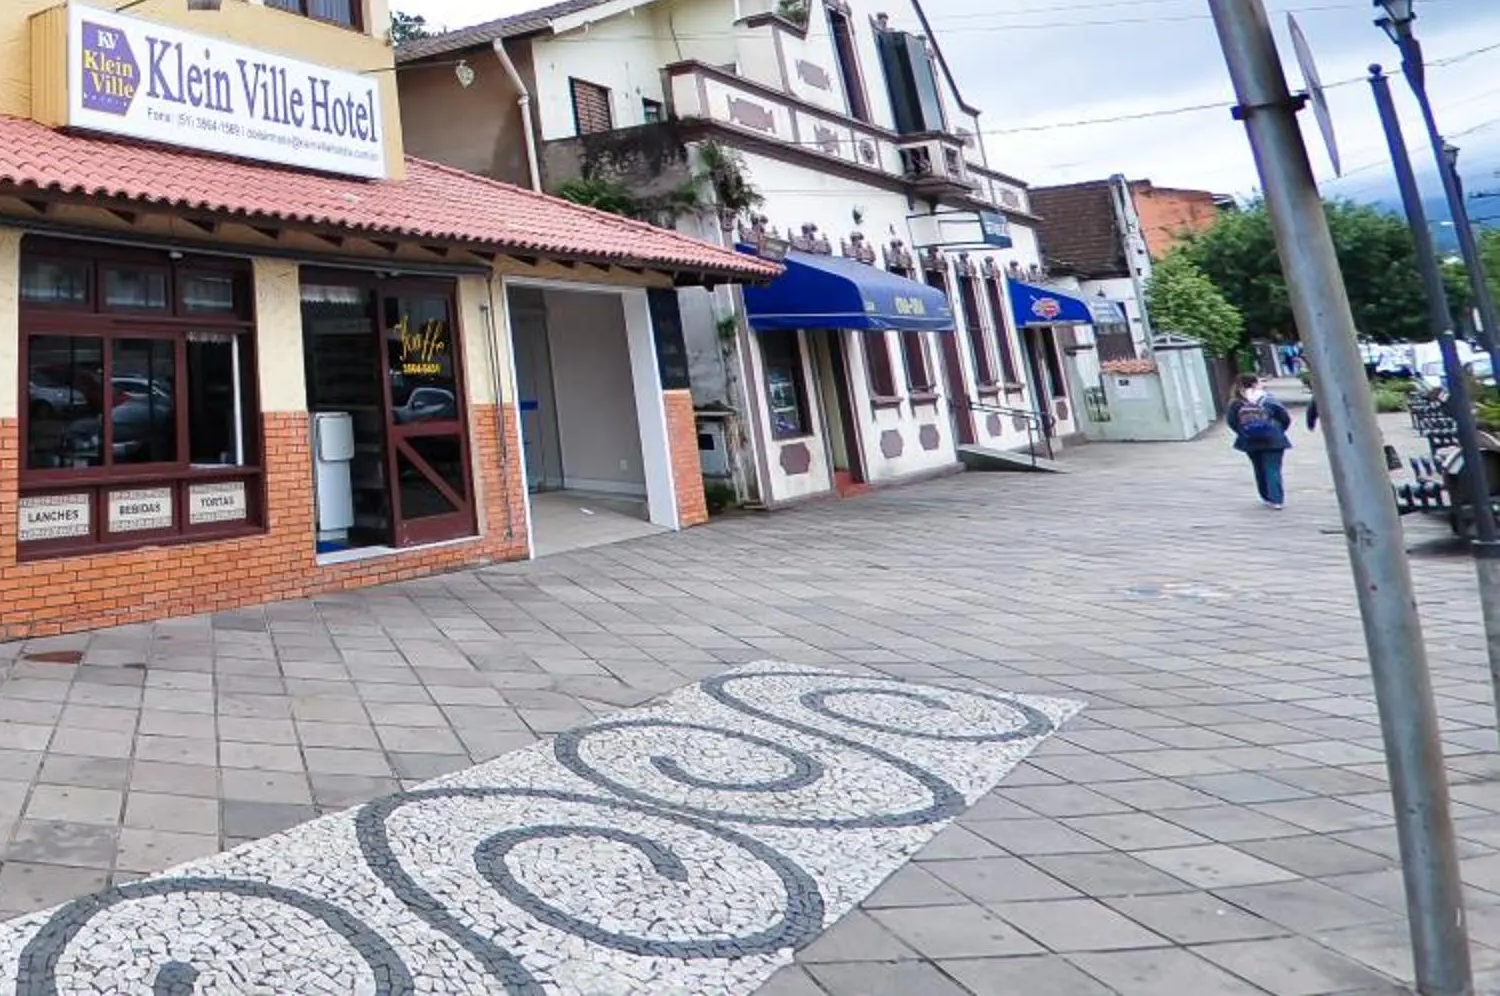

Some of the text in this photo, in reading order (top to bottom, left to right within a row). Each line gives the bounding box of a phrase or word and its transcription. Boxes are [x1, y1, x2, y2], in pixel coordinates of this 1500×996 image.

[83, 49, 133, 78] Klein
[89, 70, 134, 99] Ville
[145, 35, 378, 143] Klein Ville Hotel
[119, 503, 161, 516] BEBIDAS
[200, 496, 235, 508] TORTAS
[27, 508, 79, 523] LANCHES
